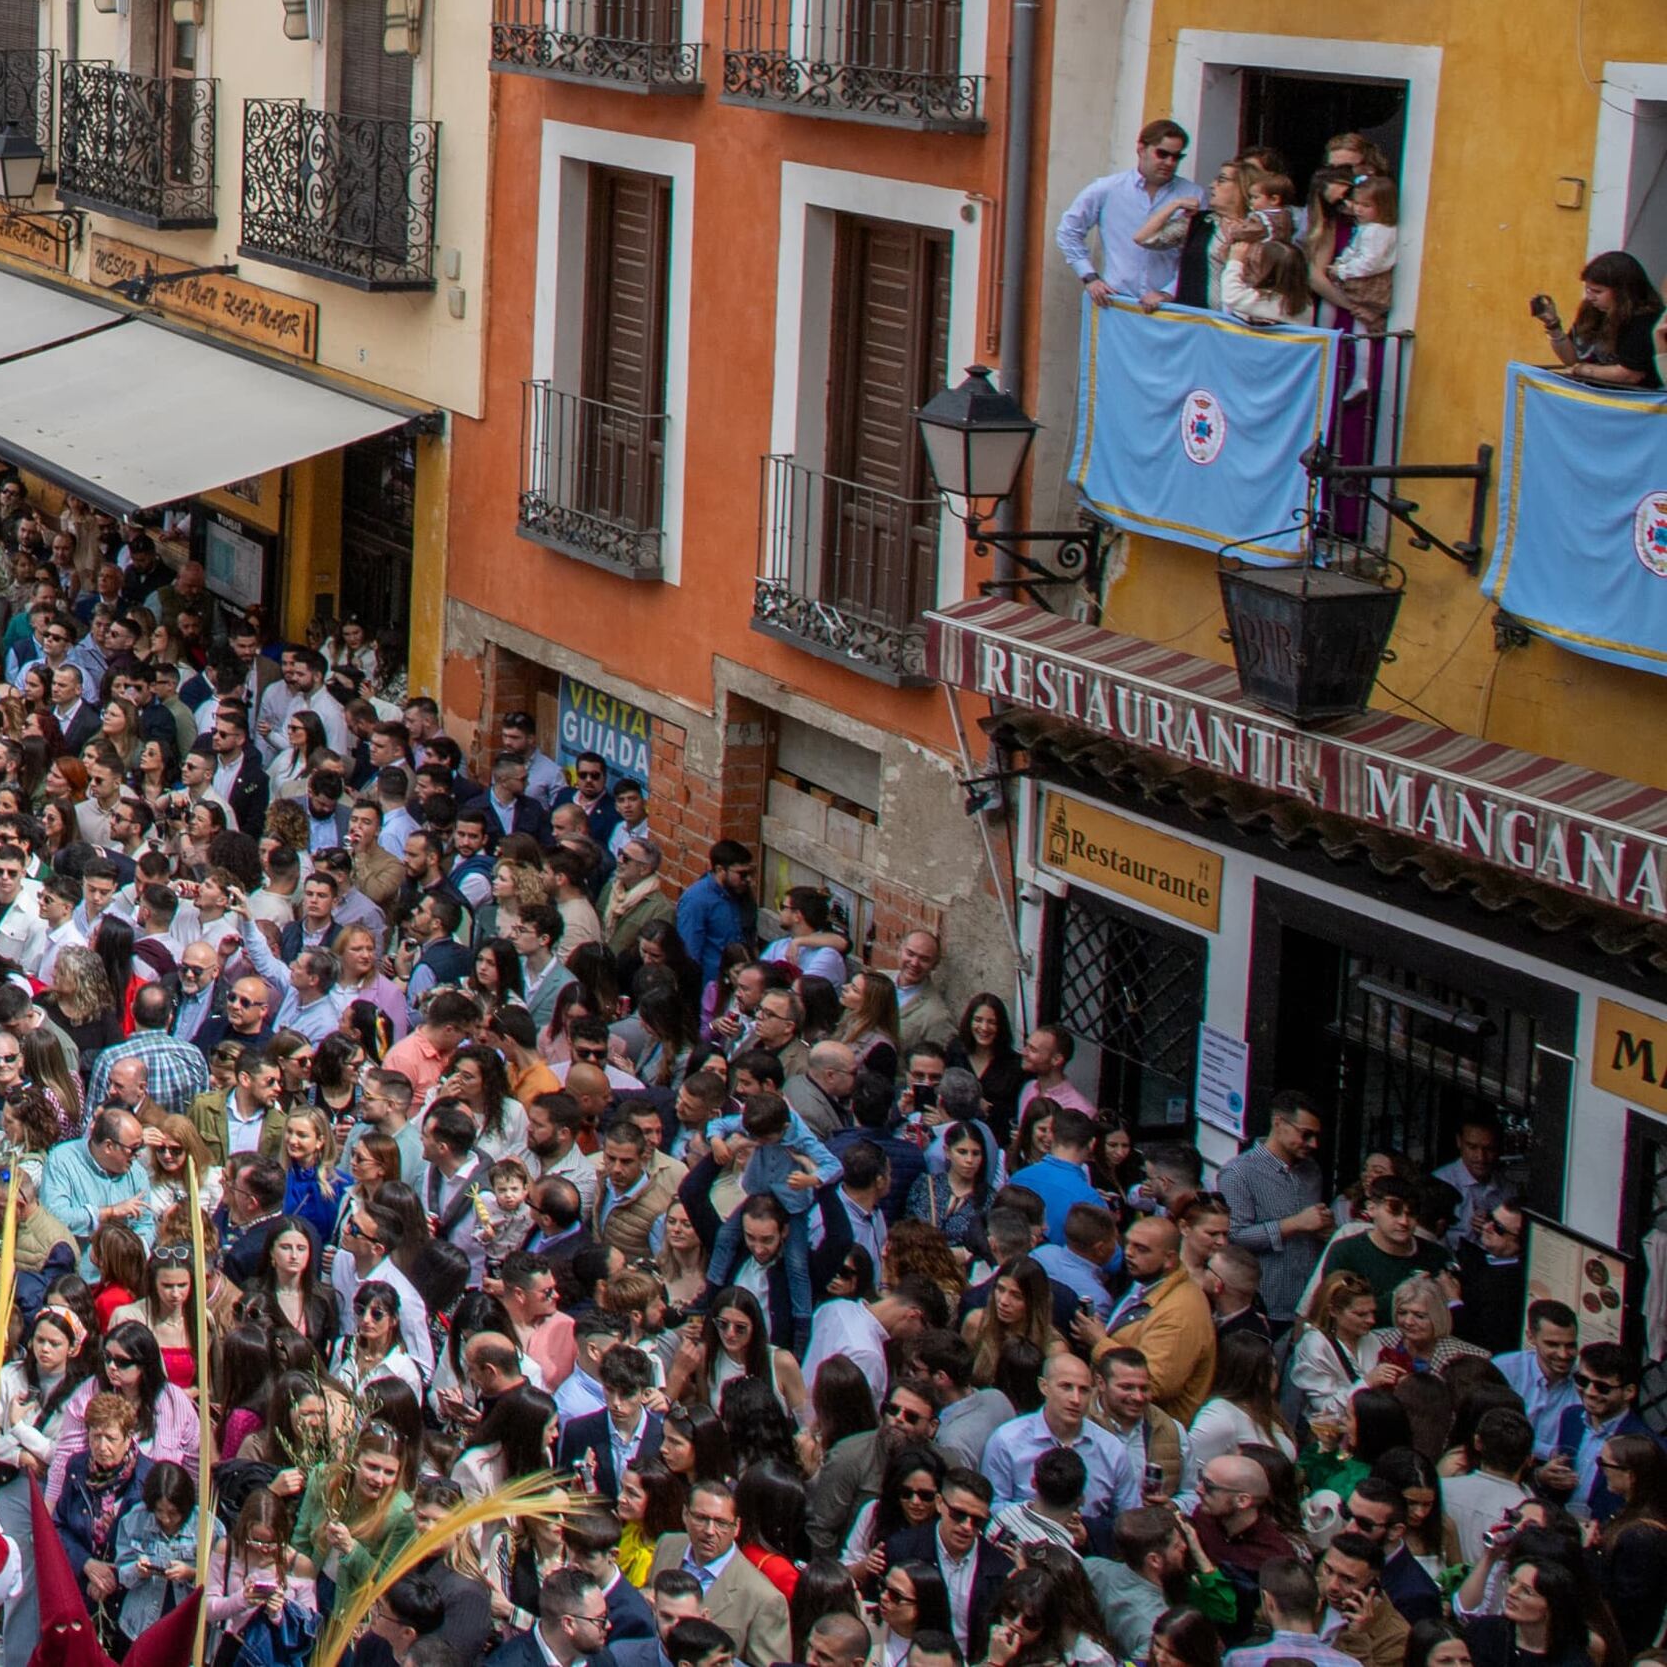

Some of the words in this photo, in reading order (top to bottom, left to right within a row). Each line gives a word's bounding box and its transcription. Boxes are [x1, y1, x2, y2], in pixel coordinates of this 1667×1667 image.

[258, 301, 301, 338] MAYOR
[563, 710, 649, 777] GUIADA
[569, 681, 647, 740] VISITA
[980, 642, 1309, 798] RESTAURANTE
[1366, 765, 1667, 914] MANGANA
[1070, 828, 1210, 908] Restaurante
